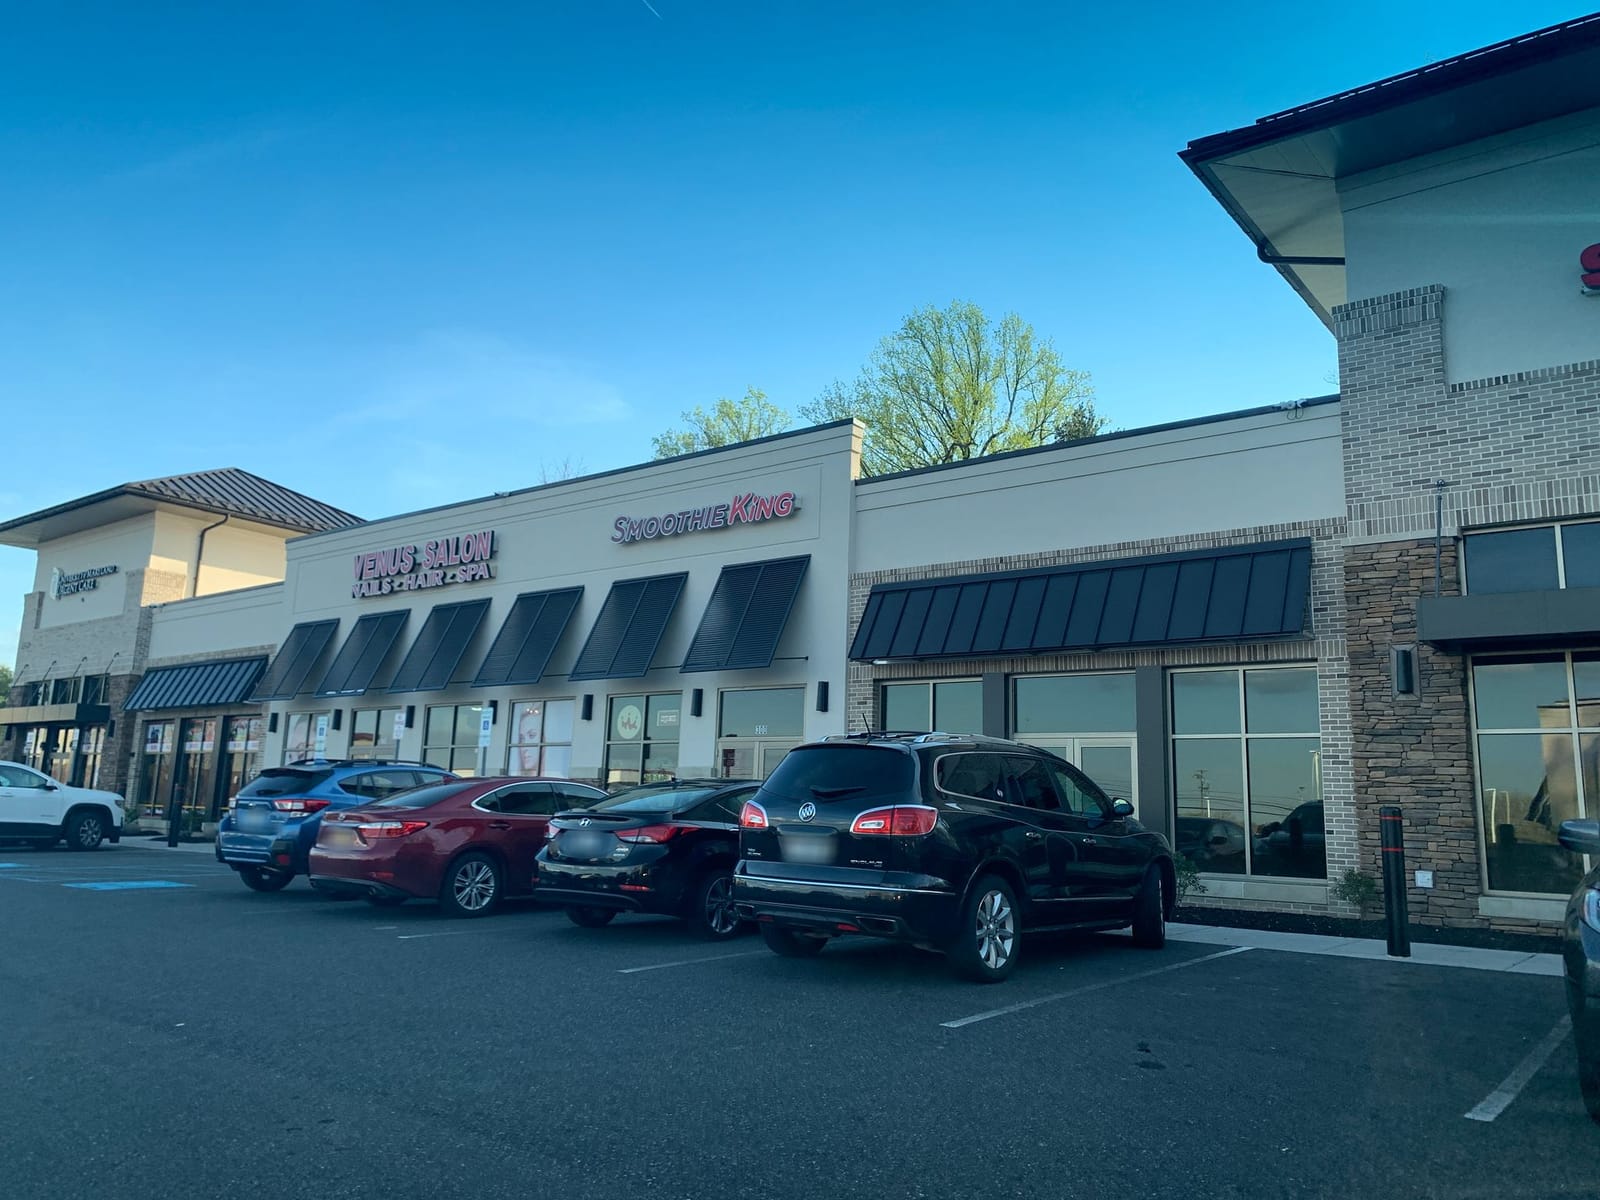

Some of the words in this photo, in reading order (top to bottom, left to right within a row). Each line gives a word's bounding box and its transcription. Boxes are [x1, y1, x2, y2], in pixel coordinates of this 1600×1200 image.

[611, 504, 728, 544] SMOOTHIE
[353, 544, 416, 580] VENUS
[422, 530, 495, 569] SALON
[352, 577, 394, 599] NAILS
[403, 570, 446, 591] HAIR
[456, 562, 491, 584] SPA
